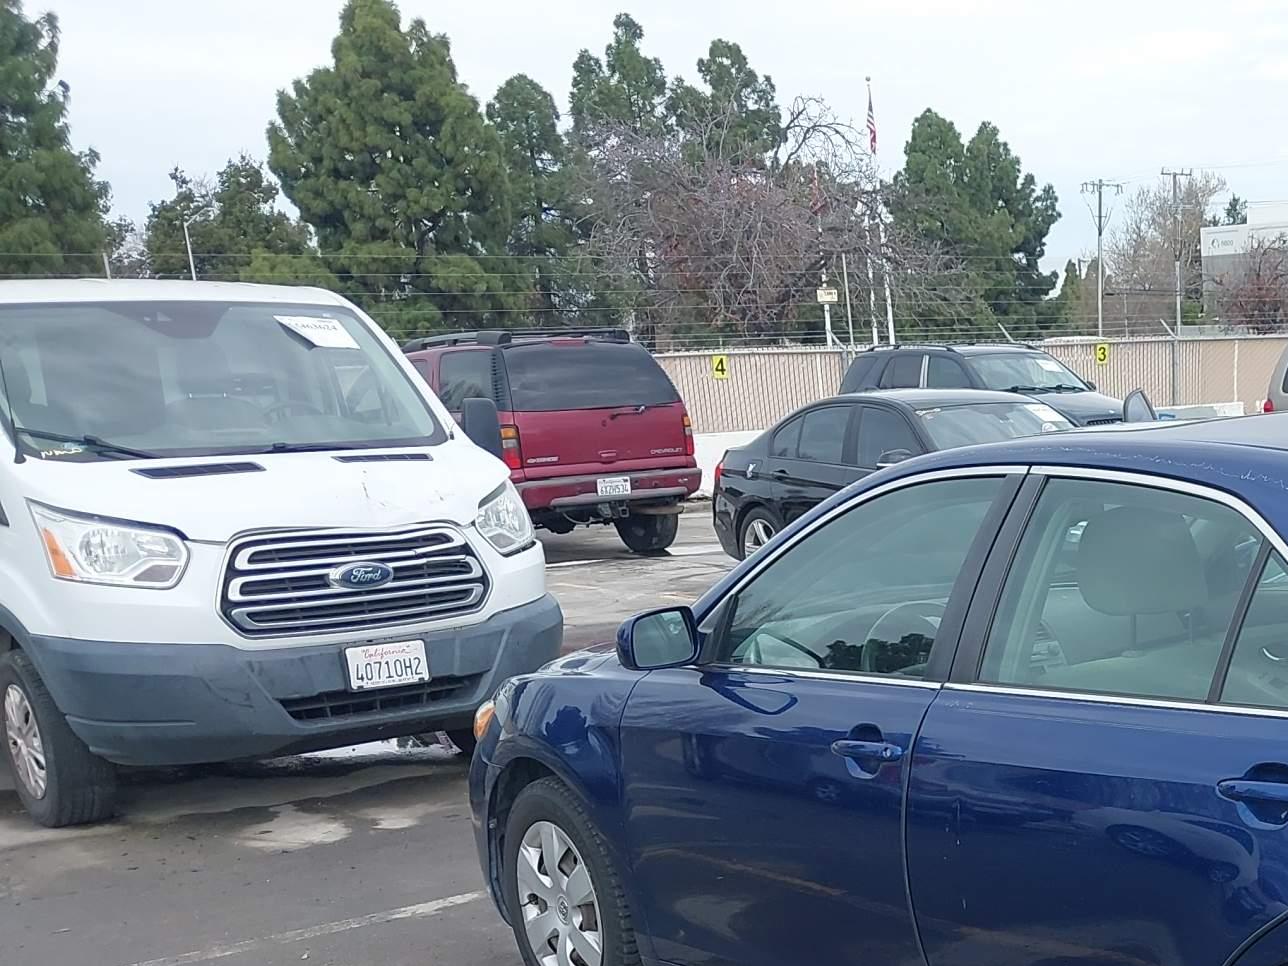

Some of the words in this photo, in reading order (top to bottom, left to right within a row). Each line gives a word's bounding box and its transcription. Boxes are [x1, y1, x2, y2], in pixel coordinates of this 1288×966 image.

[1098, 346, 1107, 362] 3
[715, 357, 726, 375] 4
[350, 567, 382, 583] Ford
[363, 647, 410, 660] California
[356, 656, 423, 682] 40710H2
